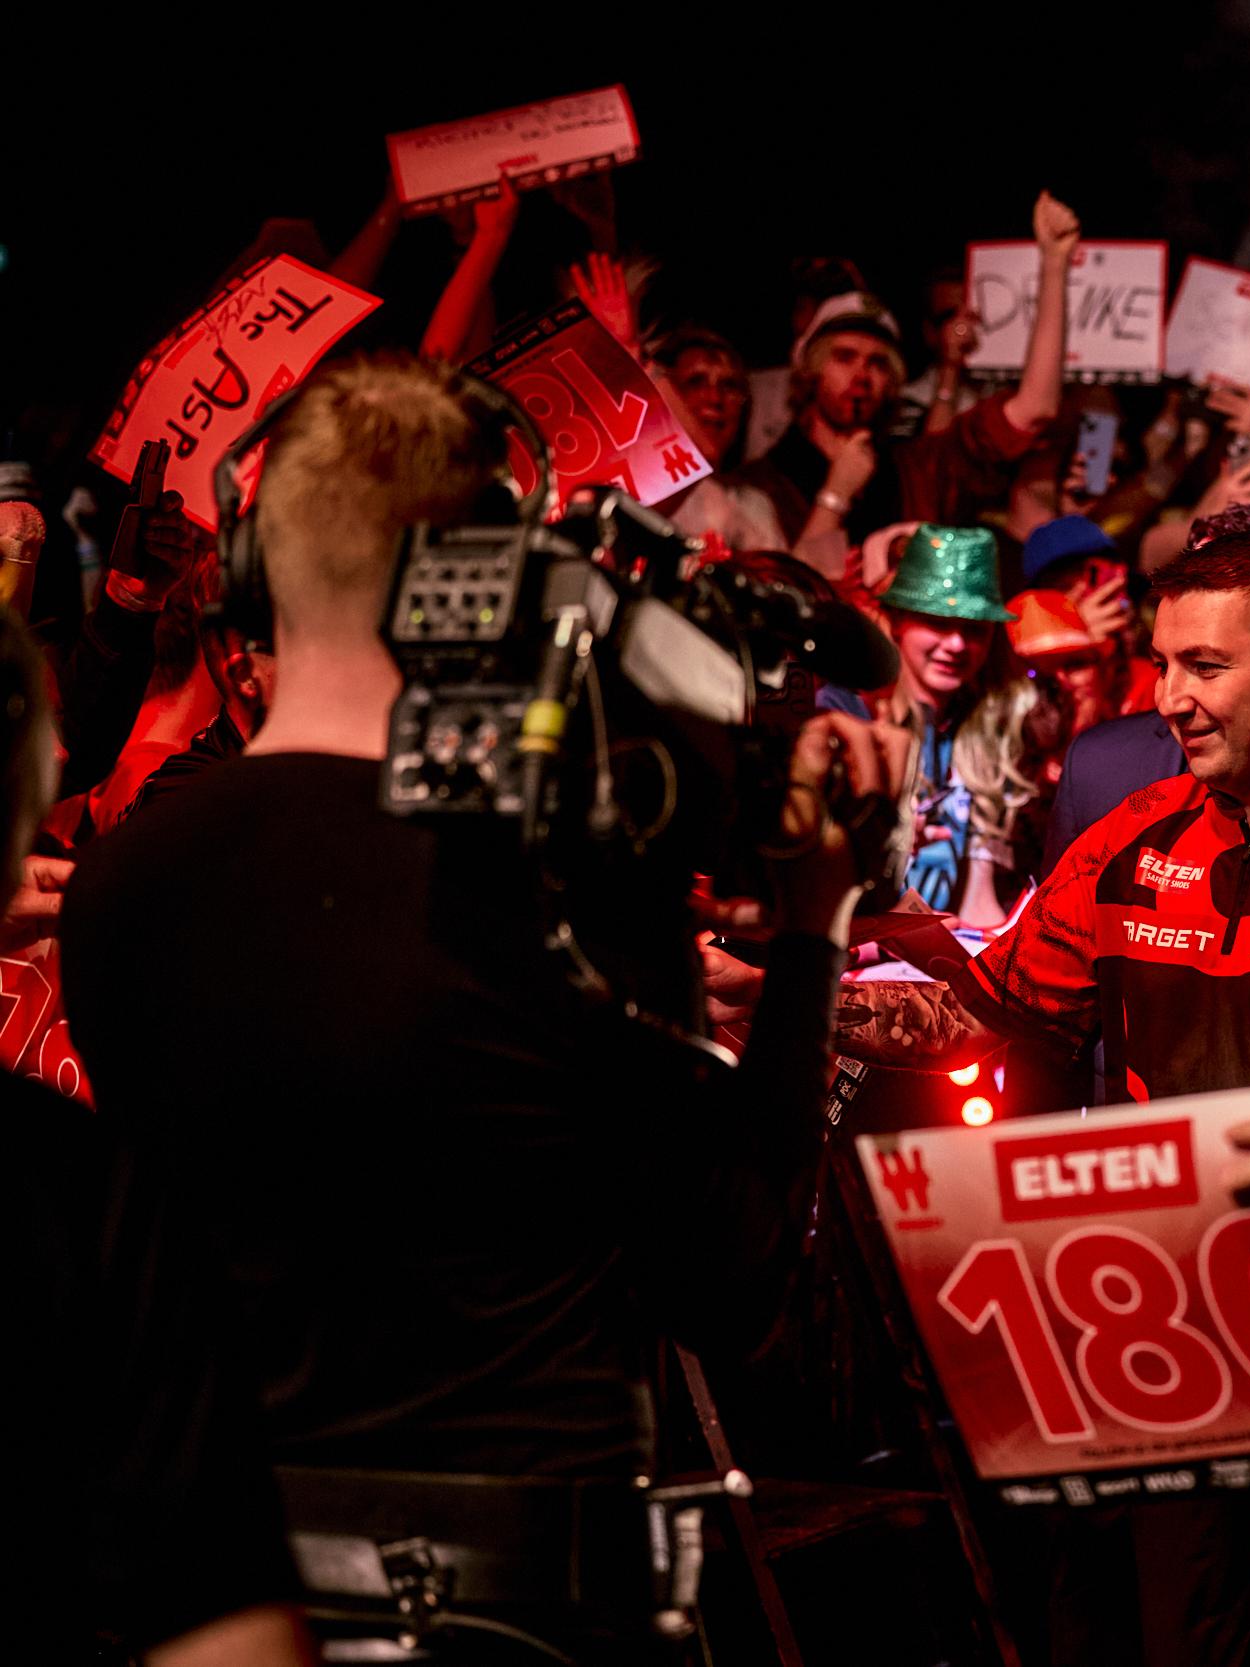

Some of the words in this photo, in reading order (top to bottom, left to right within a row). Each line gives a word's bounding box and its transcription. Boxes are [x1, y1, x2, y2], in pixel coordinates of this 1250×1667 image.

[239, 286, 334, 342] The
[1139, 854, 1205, 881] ELTEN
[1146, 872, 1171, 887] SAFETY
[1170, 879, 1191, 890] SHOES
[1011, 1141, 1181, 1201] ELTEN
